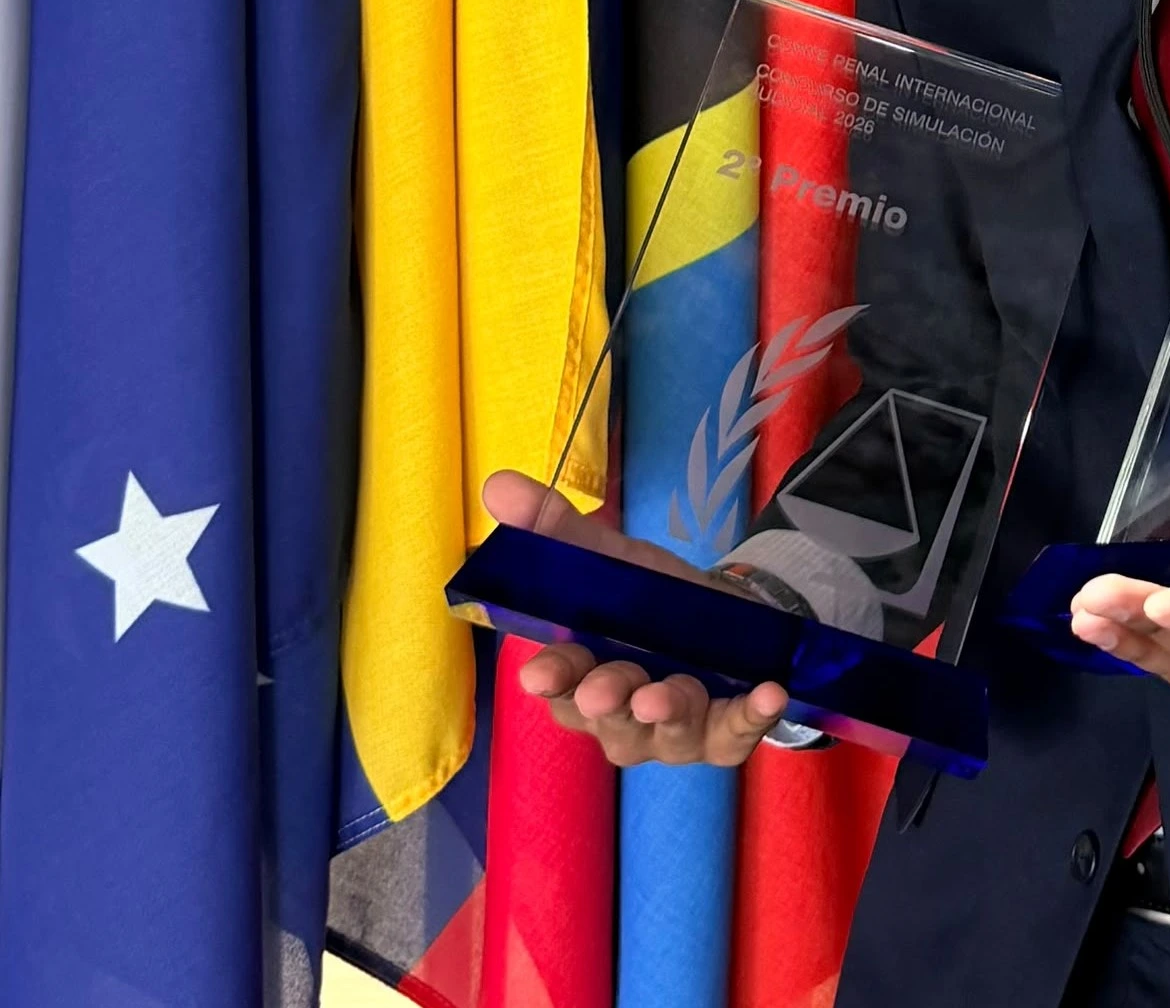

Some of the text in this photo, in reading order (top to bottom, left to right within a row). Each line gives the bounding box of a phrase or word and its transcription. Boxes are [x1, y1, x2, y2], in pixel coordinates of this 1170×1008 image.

[833, 54, 1036, 130] PENAL INTERNACIONAL
[834, 110, 875, 134] 2026
[863, 96, 890, 117] DE
[892, 106, 1005, 153] SIMULACIÓN
[771, 163, 908, 230] Premio
